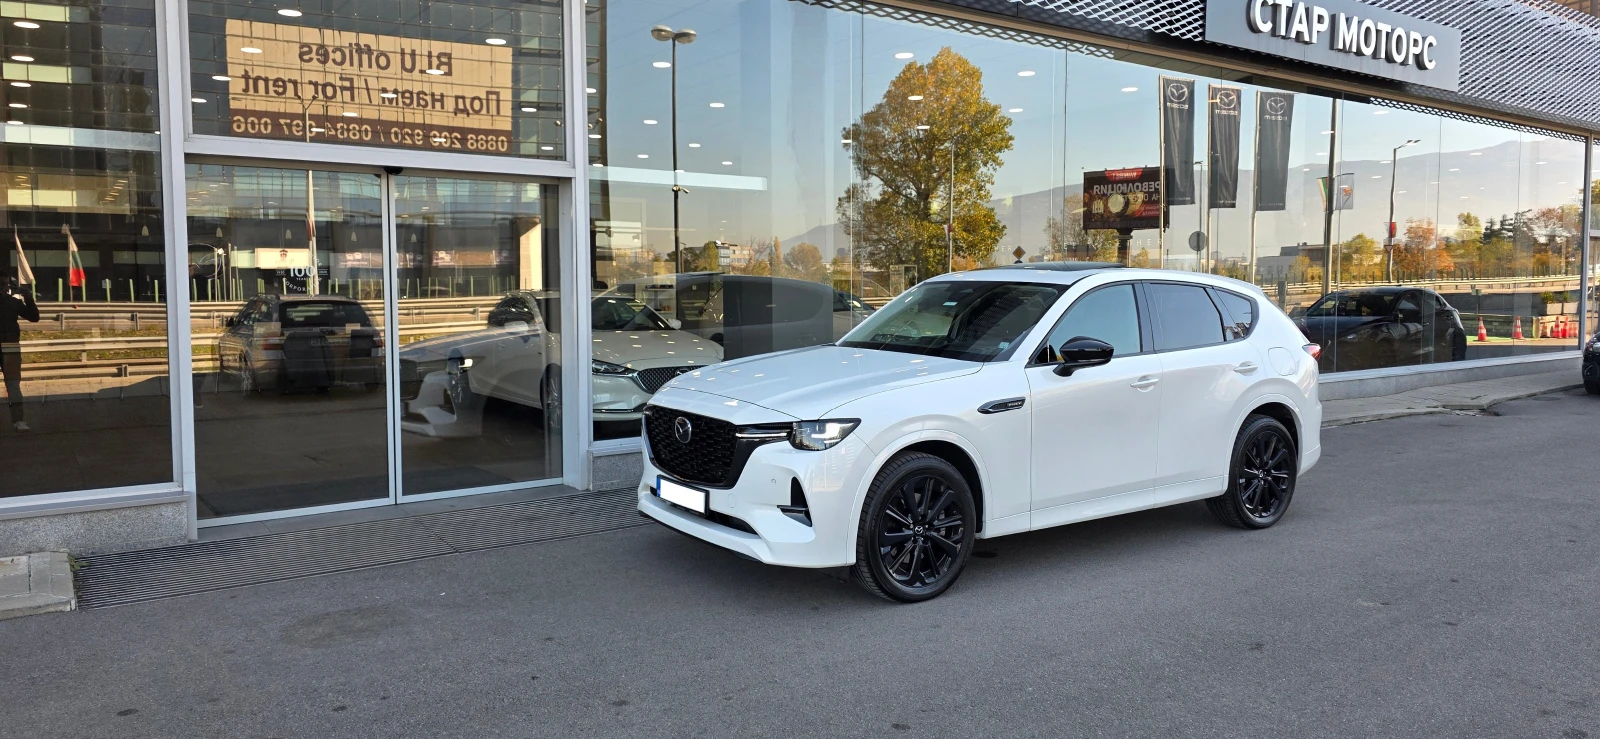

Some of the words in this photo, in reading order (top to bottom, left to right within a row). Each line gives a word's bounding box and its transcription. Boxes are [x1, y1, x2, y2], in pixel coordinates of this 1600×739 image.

[1248, 0, 1329, 44] СТАР
[1333, 12, 1437, 70] МОТОРС
[290, 266, 315, 277] 100
